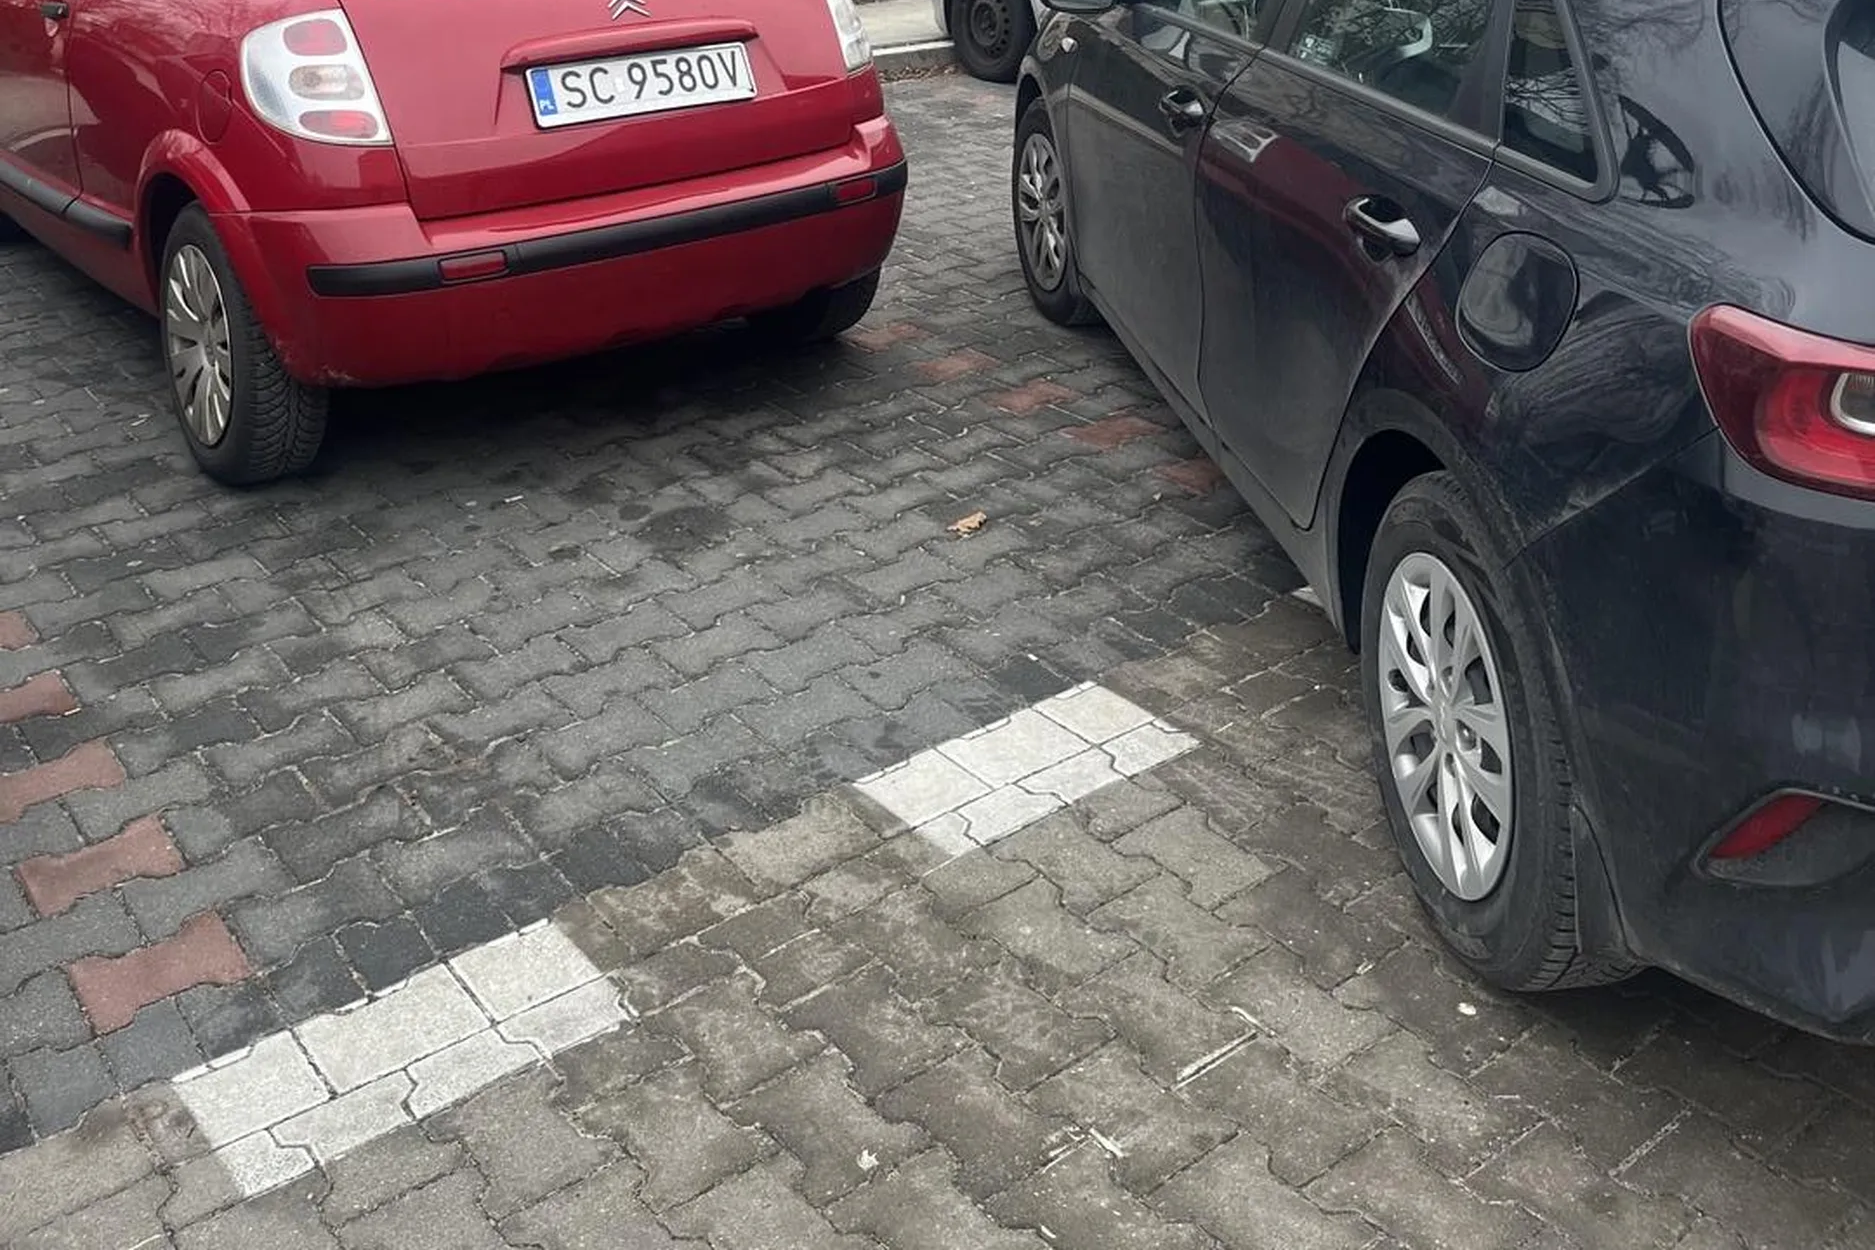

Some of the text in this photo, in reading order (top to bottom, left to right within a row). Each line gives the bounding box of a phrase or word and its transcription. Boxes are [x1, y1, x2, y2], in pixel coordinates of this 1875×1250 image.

[561, 51, 736, 108] SC 9580V
[540, 99, 555, 111] PL
